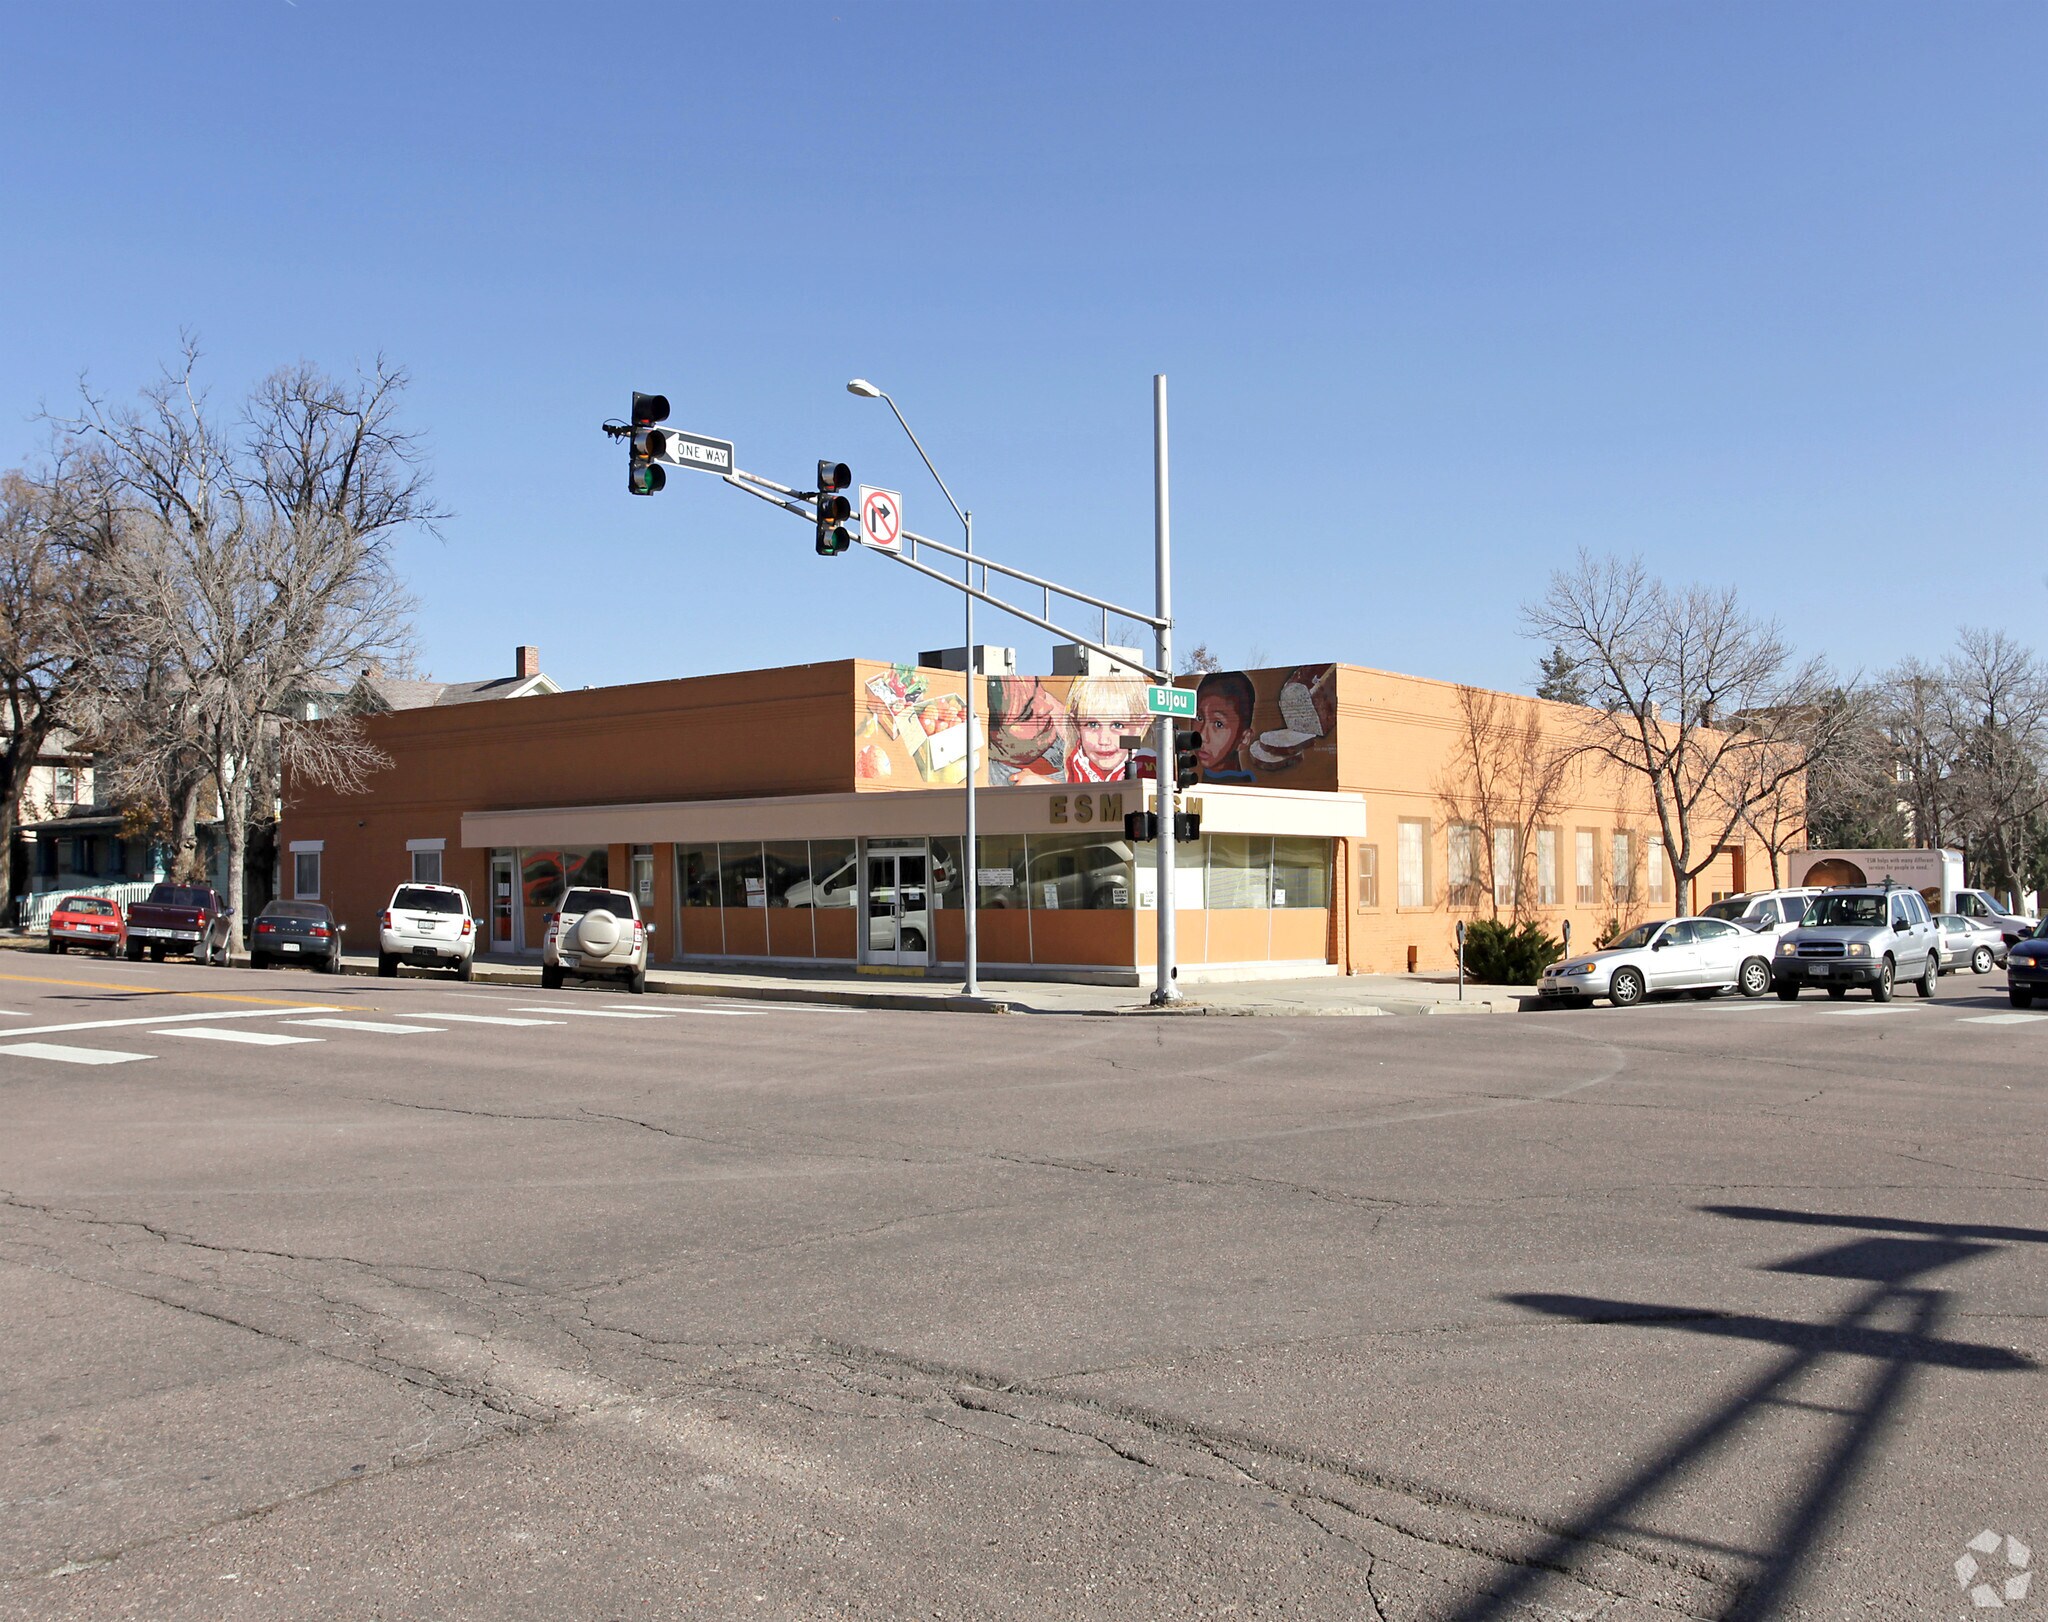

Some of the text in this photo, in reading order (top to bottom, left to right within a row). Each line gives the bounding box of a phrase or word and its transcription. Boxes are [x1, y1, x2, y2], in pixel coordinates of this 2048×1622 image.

[678, 442, 726, 463] ONE WAY
[1157, 690, 1187, 711] Bijou
[1050, 794, 1122, 824] ESM
